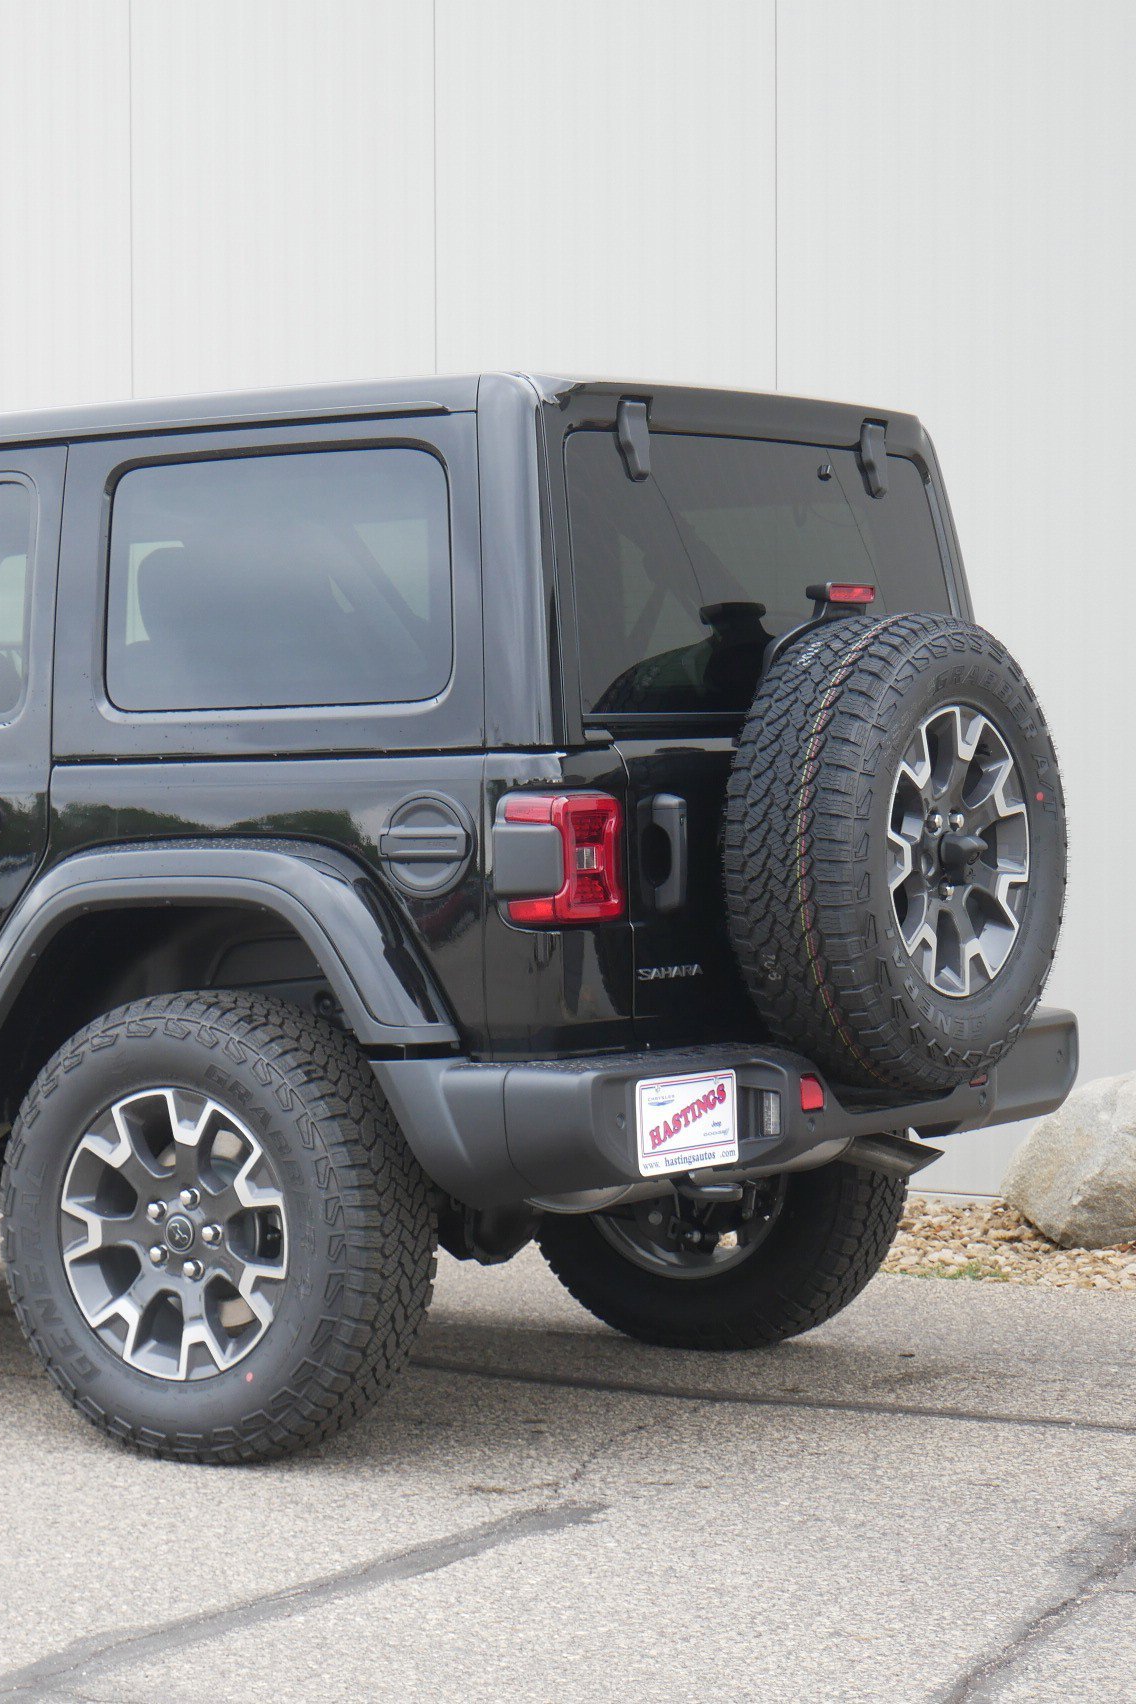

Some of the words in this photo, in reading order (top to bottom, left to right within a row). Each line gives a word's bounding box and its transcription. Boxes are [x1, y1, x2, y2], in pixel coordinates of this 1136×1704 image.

[933, 664, 1038, 742] GRABBER
[636, 964, 704, 981] SAHARA
[647, 1094, 675, 1102] CHRYSLER
[649, 1083, 727, 1150] HASTINGS
[711, 1120, 722, 1128] Jeep
[664, 1151, 716, 1167] hastingsautos
